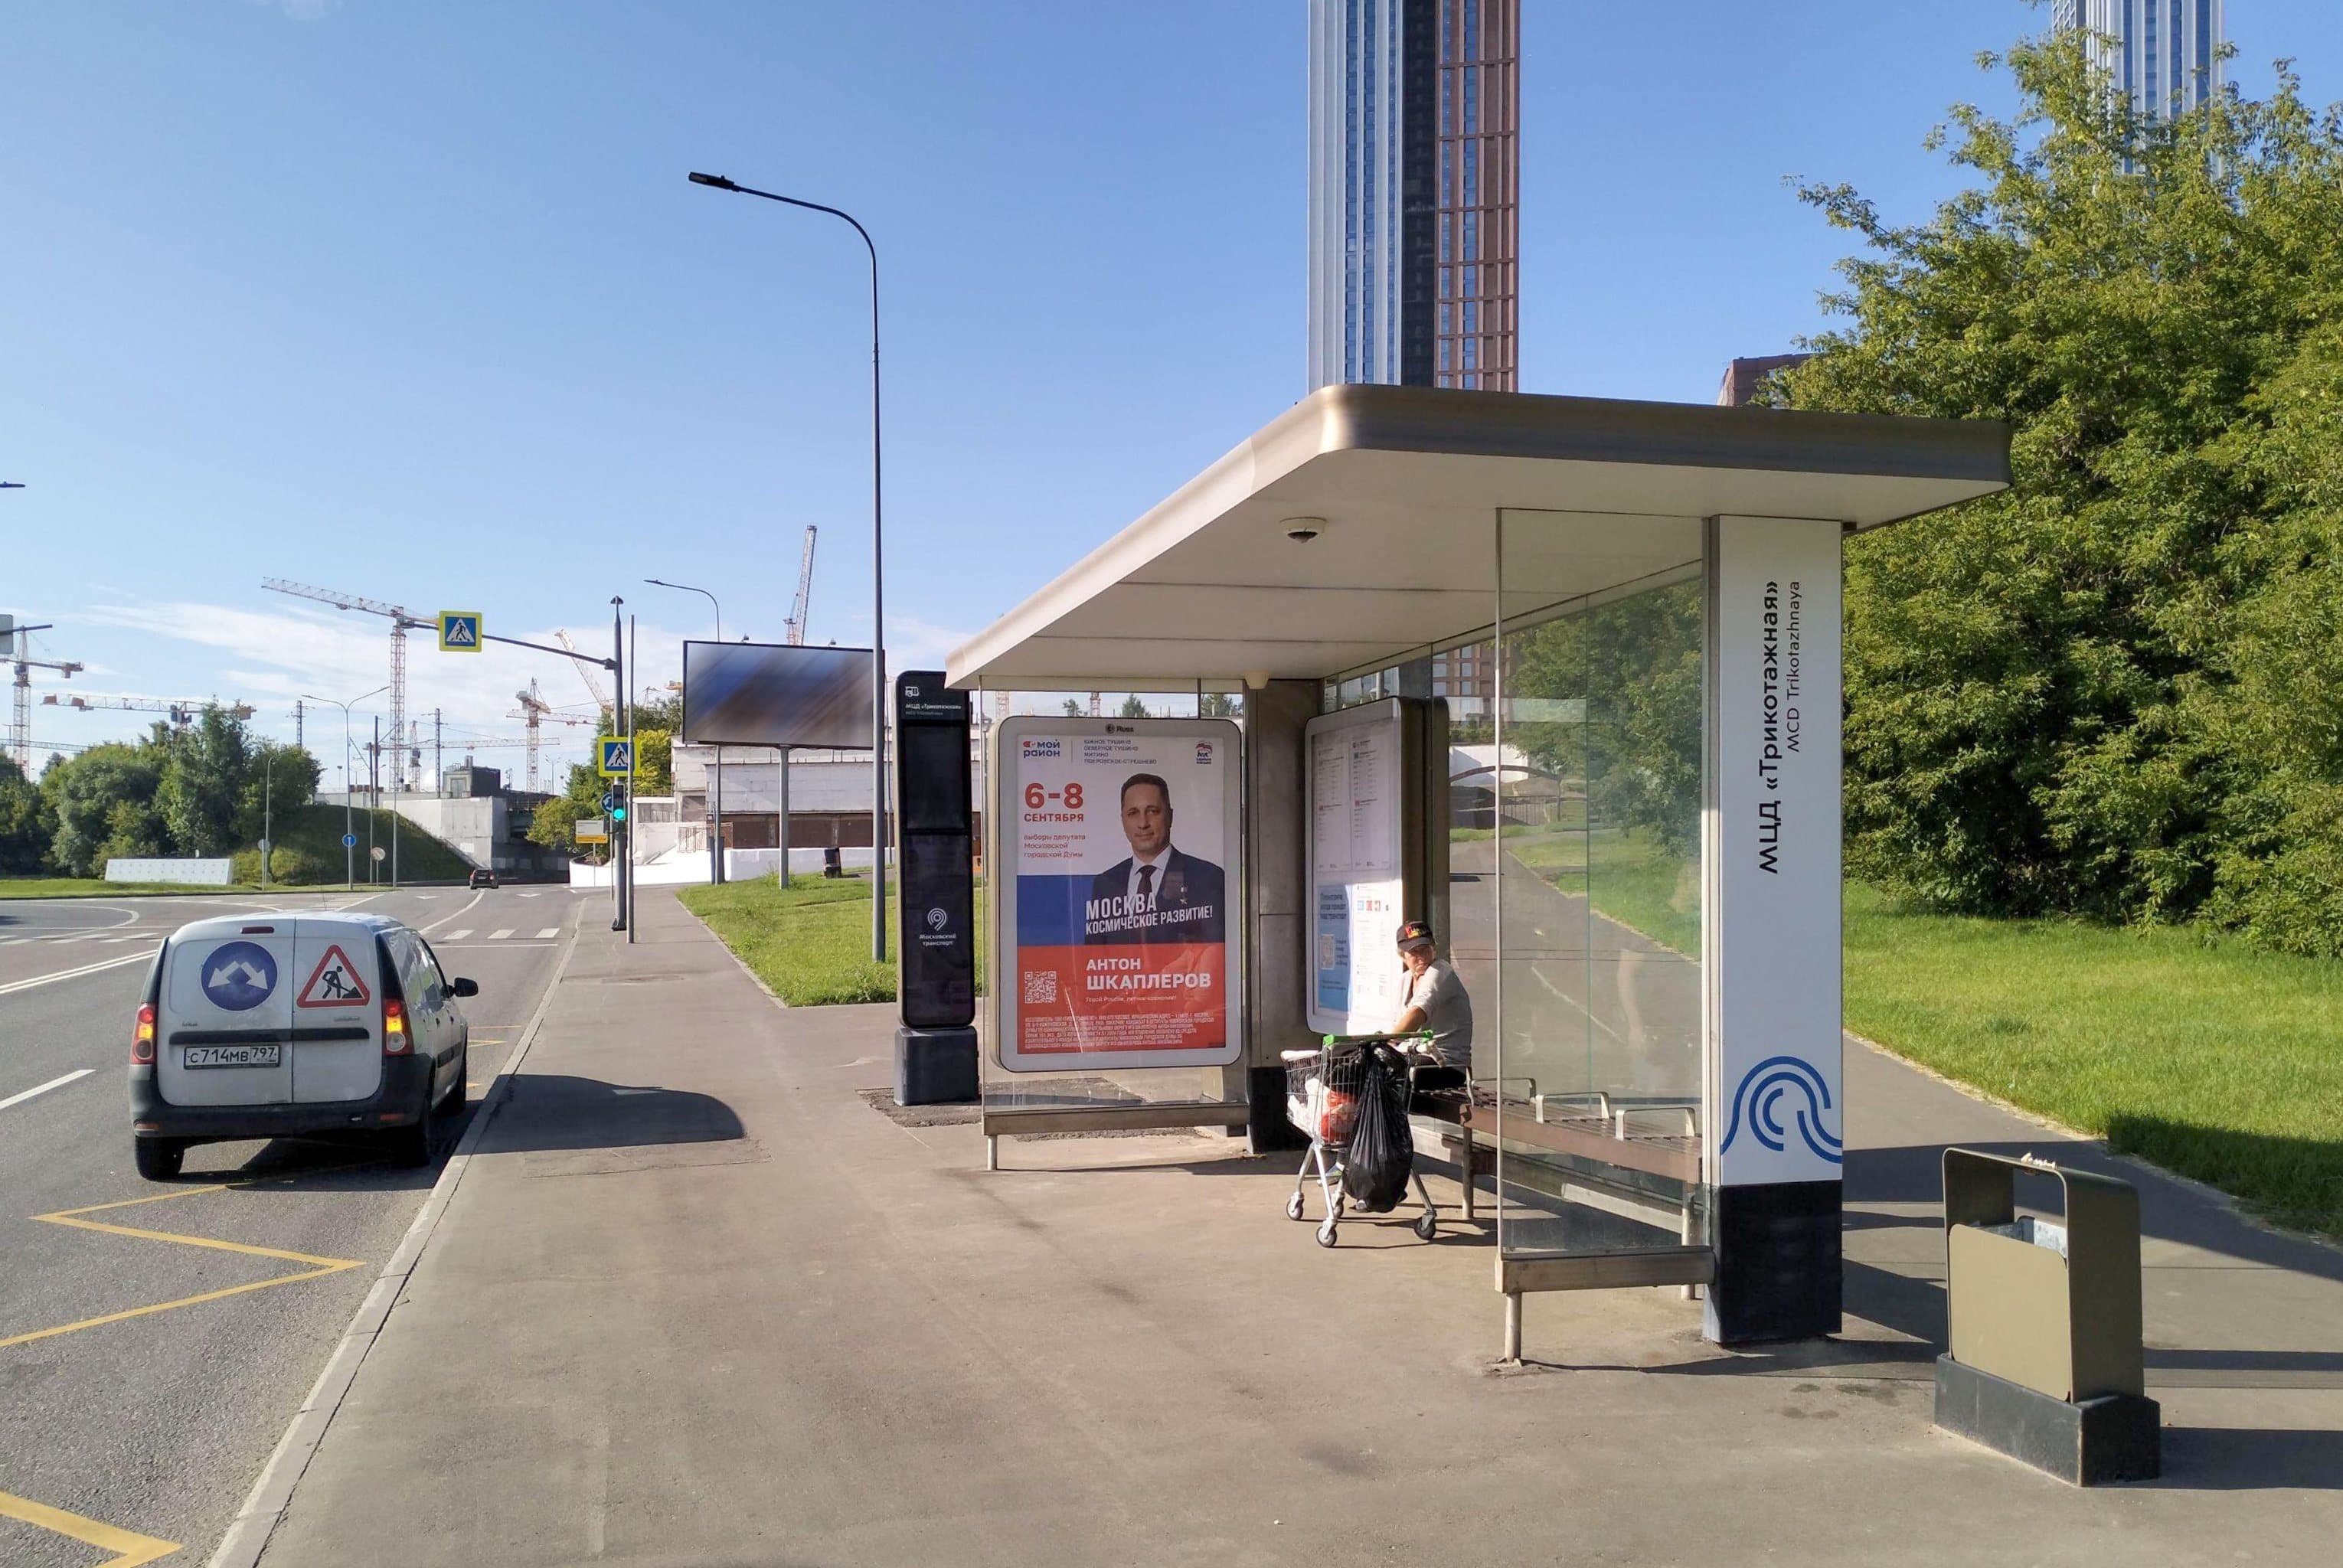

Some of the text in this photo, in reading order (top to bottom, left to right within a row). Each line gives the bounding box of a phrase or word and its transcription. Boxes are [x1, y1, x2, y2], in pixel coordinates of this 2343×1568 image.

[1786, 580, 1802, 752] MCD Trikotazhnaya
[1759, 580, 1783, 874] МЦД «Трикотажная»
[1024, 813, 1084, 822] СЕНТЯБРЯ
[1086, 892, 1158, 920] МОСКВА
[1086, 905, 1214, 936] КОСМИЧЕСКОЕ РАЗВИТИЕ!
[1086, 958, 1141, 971] АНТОН
[1087, 973, 1212, 991] ШКАПЛЕРОВ
